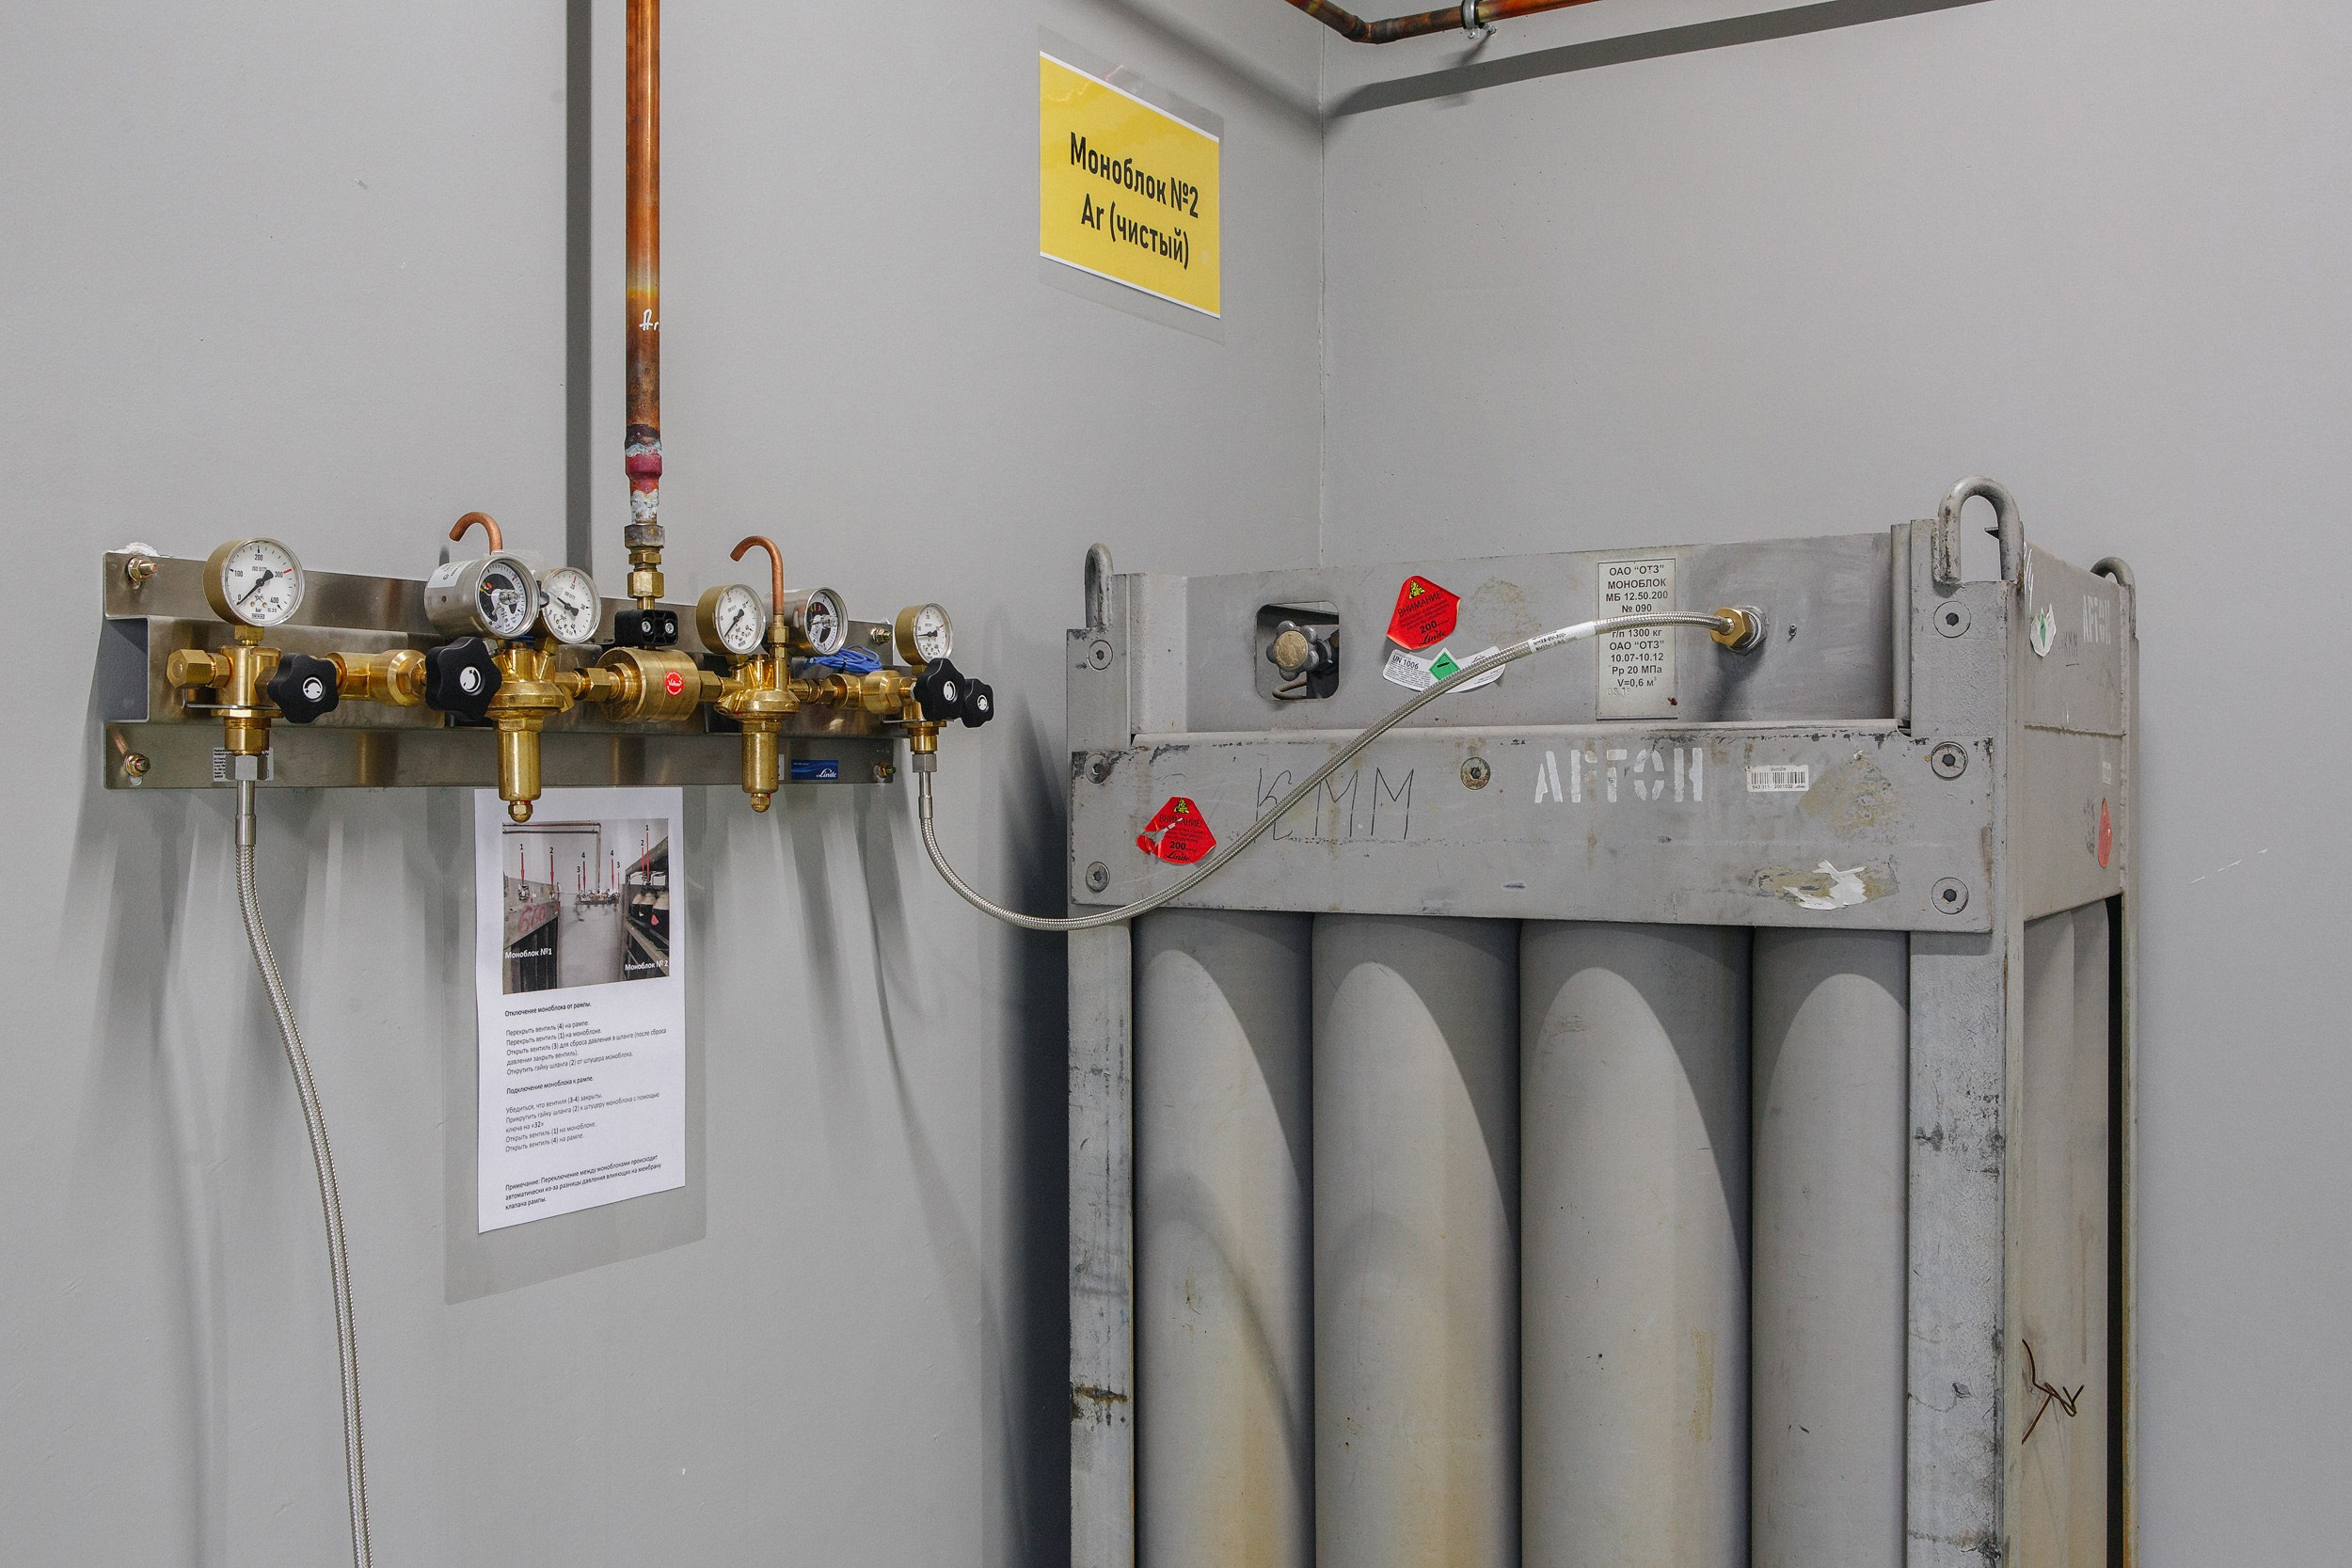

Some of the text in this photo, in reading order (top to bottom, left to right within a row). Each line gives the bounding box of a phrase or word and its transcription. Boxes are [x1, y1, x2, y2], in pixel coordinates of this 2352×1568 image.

[1071, 132, 1199, 219] Моноблок №2
[1081, 193, 1189, 271] Ar (чистый)
[254, 553, 263, 562] 200
[1609, 566, 1631, 576] ОАО
[1608, 578, 1667, 590] МОНОБЛОК
[1606, 591, 1669, 602] МБ 12.50.200
[1398, 589, 1444, 617] ВНИМАНИЕ!
[1622, 604, 1652, 613] № 090
[1420, 620, 1438, 634] 200
[1419, 629, 1446, 647] Linde
[1612, 629, 1625, 638] г/п
[1628, 628, 1650, 638] 1300
[1609, 641, 1631, 651] ОАО
[1392, 655, 1401, 664] UN
[1404, 658, 1419, 670] 1006
[1611, 653, 1664, 663] 10.07-10.12
[1628, 665, 1639, 674] 20
[1641, 665, 1662, 673] МПа
[816, 768, 837, 778] Linde
[1534, 747, 1703, 803] АРГОН
[1169, 841, 1186, 850] 200
[1163, 850, 1190, 862] Linde
[505, 949, 539, 959] Моноблок
[625, 961, 656, 971] Моноблок
[504, 1008, 537, 1018] Отключение
[537, 1005, 566, 1013] моноблока
[506, 1028, 535, 1037] Перекрыть
[506, 1037, 535, 1046] Перекрыть
[506, 1048, 529, 1056] Открыть
[570, 1039, 587, 1048] сброса
[588, 1037, 612, 1045] давления
[506, 1057, 532, 1067] давления
[506, 1067, 534, 1076] Открутить
[506, 1084, 544, 1095] Подключение
[544, 1079, 573, 1089] моноблока
[546, 1099, 567, 1107] вентиля
[568, 1096, 580, 1104] (3-4)
[506, 1114, 537, 1124] Прикрутить
[606, 1097, 633, 1106] моноблока
[637, 1092, 660, 1101] помощью
[506, 1125, 523, 1133] ключа
[505, 1134, 529, 1143] Открыть
[529, 1131, 550, 1139] вентиль
[505, 1144, 529, 1153] Открыть
[529, 1140, 550, 1148] вентиль
[540, 1171, 580, 1183] Переключение
[596, 1161, 630, 1172] моноблоками
[630, 1155, 659, 1165] происходит
[505, 1188, 545, 1201] автоматически
[559, 1180, 581, 1191] разницы
[581, 1175, 606, 1185] давления
[638, 1164, 662, 1172] мембрану
[505, 1201, 527, 1211] клапана
